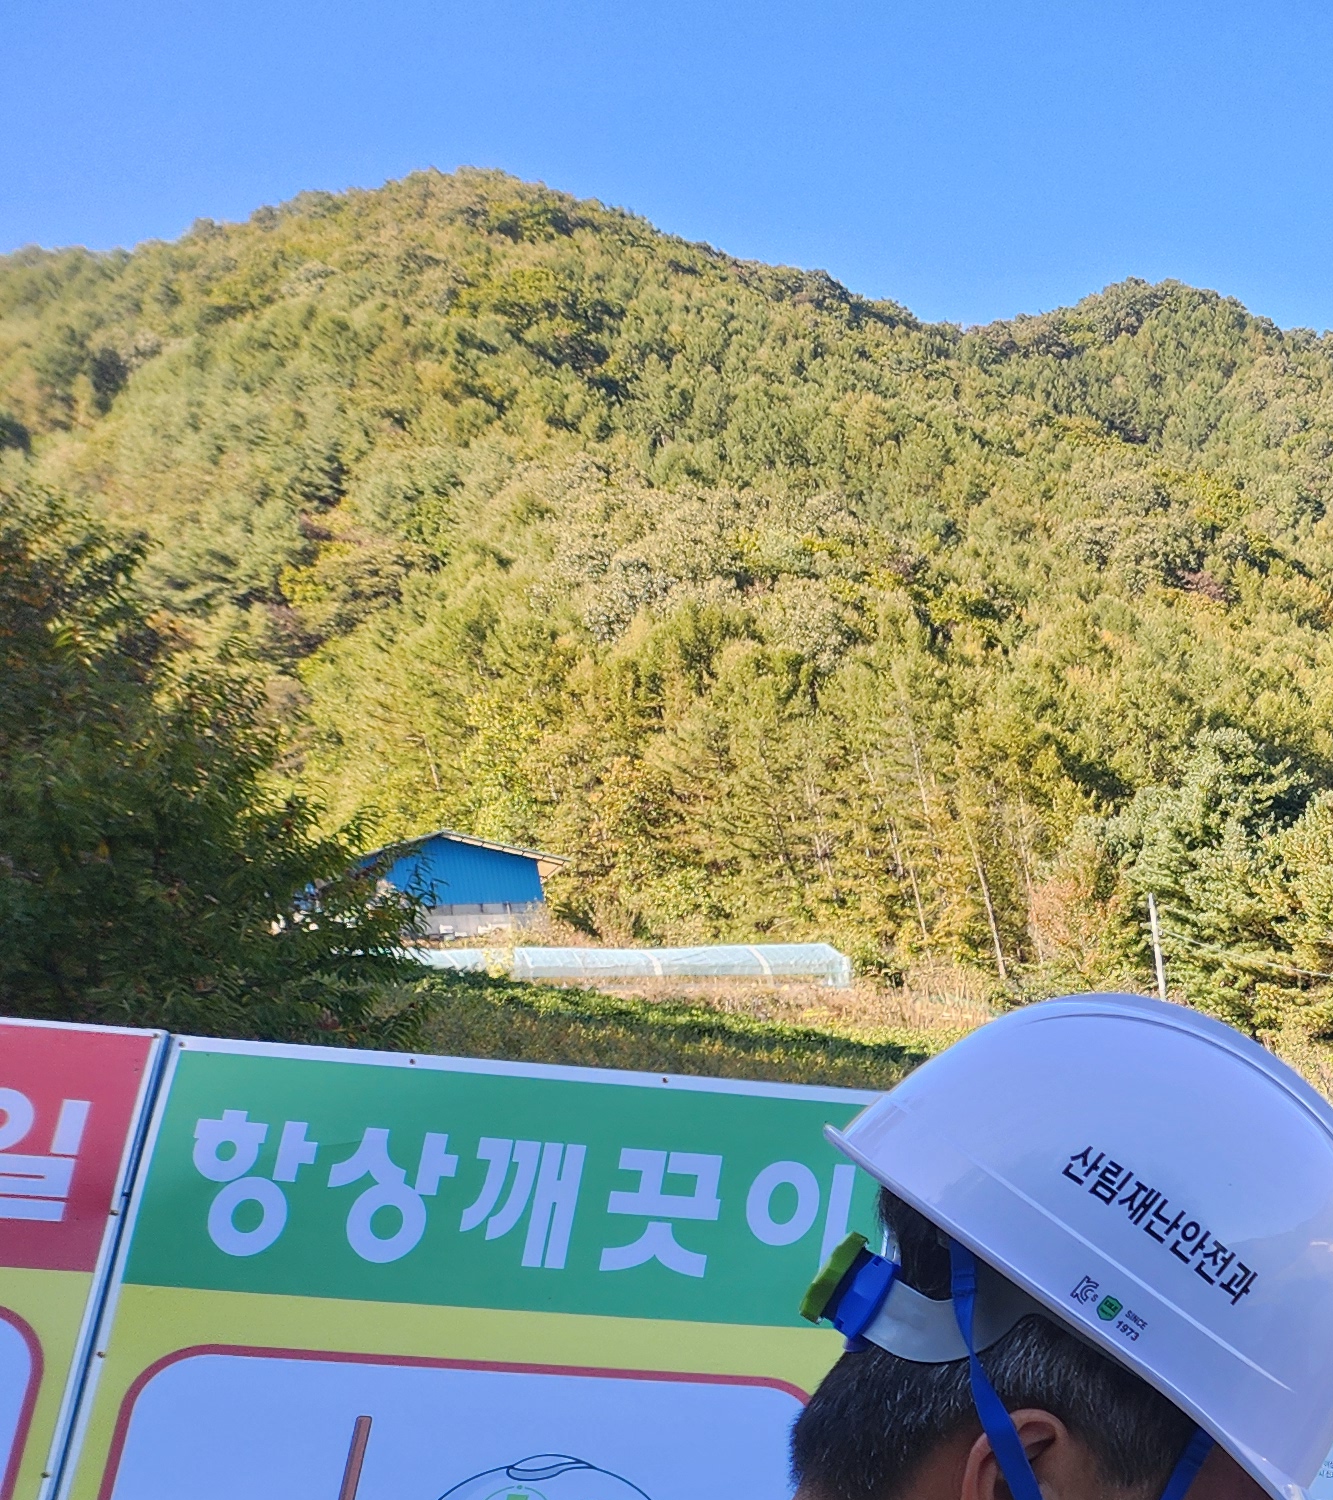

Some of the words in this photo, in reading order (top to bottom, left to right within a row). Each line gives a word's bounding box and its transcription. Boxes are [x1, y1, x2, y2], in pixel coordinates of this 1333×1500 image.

[1062, 1146, 1259, 1306] 산림재난안전과
[1116, 1320, 1140, 1341] 1973
[1125, 1310, 1148, 1331] SINCE
